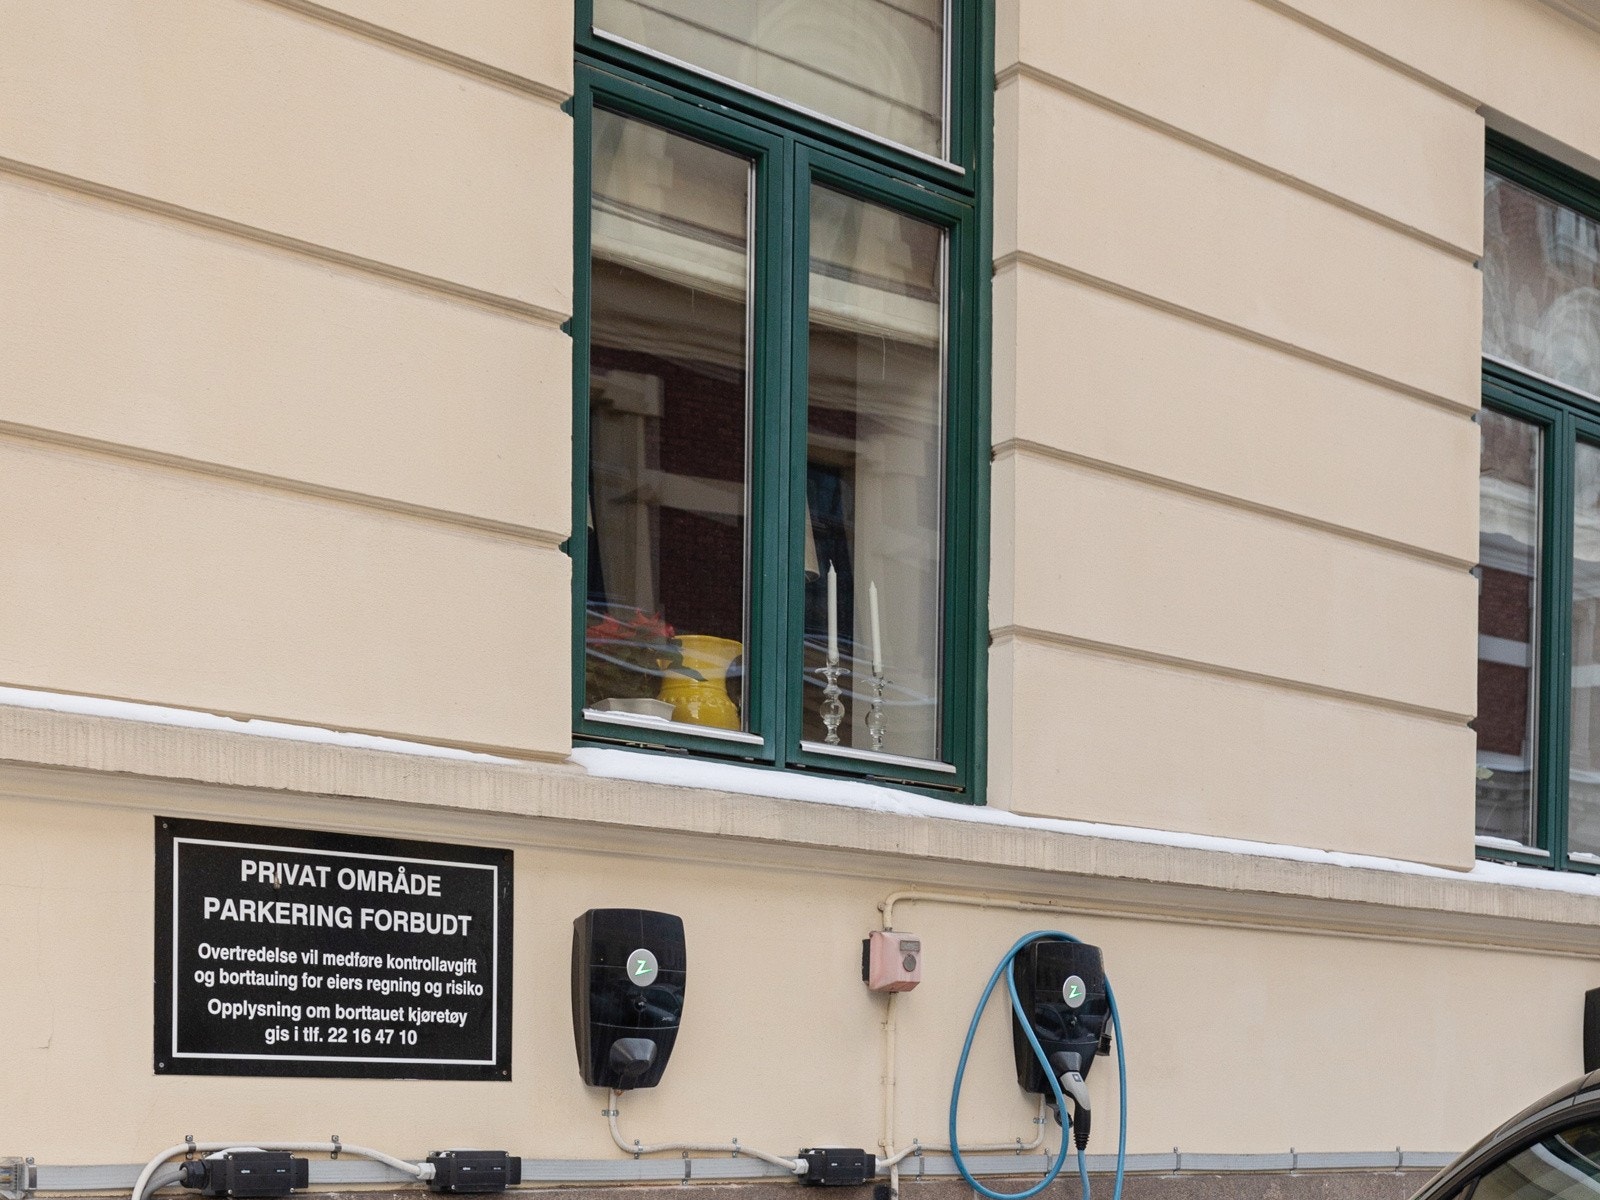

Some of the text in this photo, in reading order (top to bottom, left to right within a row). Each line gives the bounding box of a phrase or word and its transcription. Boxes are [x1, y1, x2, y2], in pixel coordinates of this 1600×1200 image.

[242, 860, 441, 896] PRIVAT OMRÅDE
[204, 897, 472, 936] PARKERING FORBUDT
[198, 943, 477, 976] Overtredelse vil medføre kontrollavgift
[194, 968, 483, 997] og borttauing for eiers regning og risiko
[208, 998, 467, 1027] Opplysning om borttauet kjøretøy
[265, 1025, 417, 1045] gis i tlf. 22 16 47 10
